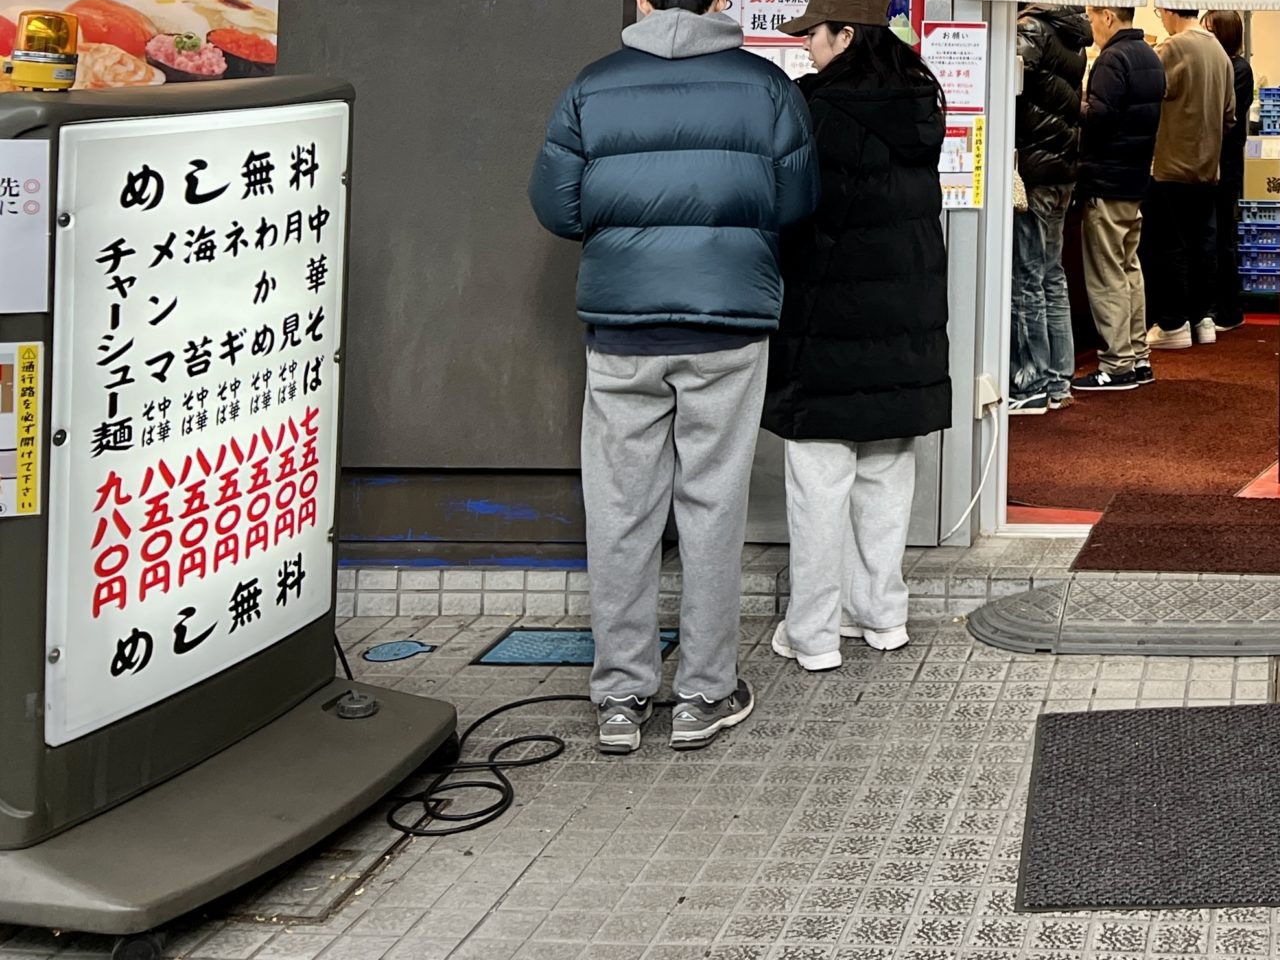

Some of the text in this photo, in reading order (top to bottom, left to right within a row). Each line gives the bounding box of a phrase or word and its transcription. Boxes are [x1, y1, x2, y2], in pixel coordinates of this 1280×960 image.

[119, 142, 320, 212] めし無料
[90, 237, 137, 458] チャーシュー麺
[302, 204, 330, 396] 中華そば
[20, 361, 36, 509] 通行路を必ず開けて下さい
[110, 552, 306, 677] めし無料
